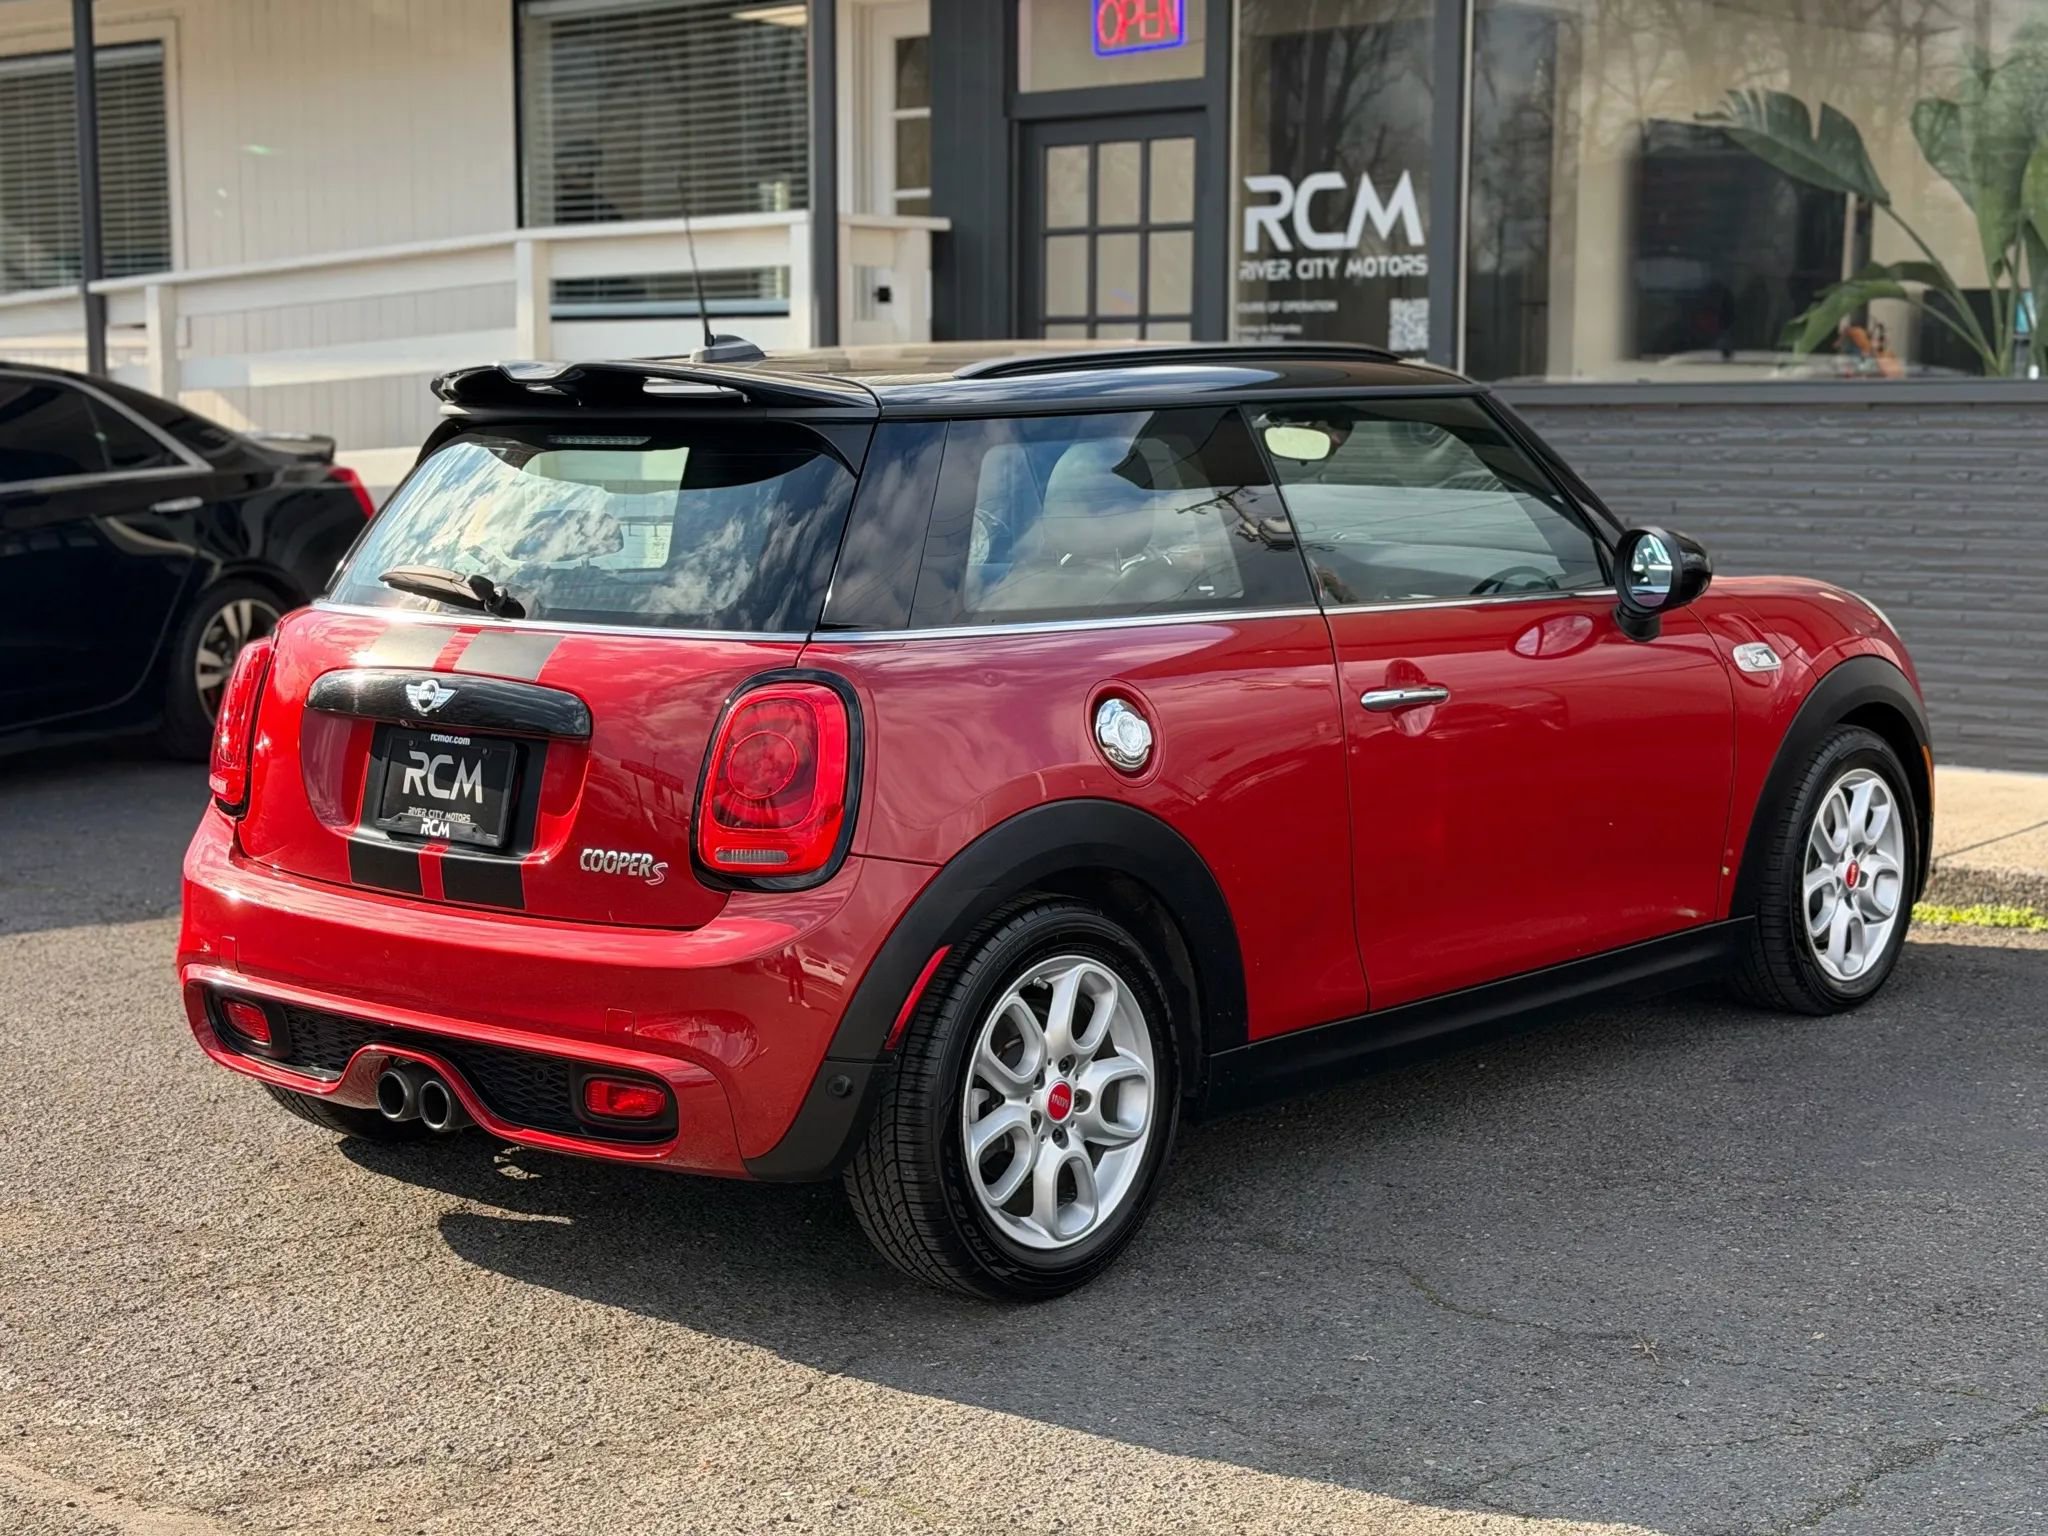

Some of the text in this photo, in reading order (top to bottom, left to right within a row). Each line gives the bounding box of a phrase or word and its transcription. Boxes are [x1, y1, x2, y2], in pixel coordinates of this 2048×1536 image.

[1097, 0, 1179, 47] OPEN
[1244, 169, 1426, 253] RCM
[1238, 254, 1429, 282] RIVER CITY MOTORS
[430, 733, 471, 746] rcmor.com
[402, 750, 483, 804] RCM
[407, 806, 471, 824] RIVER CITY MOTORS
[420, 817, 450, 838] RCM
[580, 848, 654, 878] COOPER
